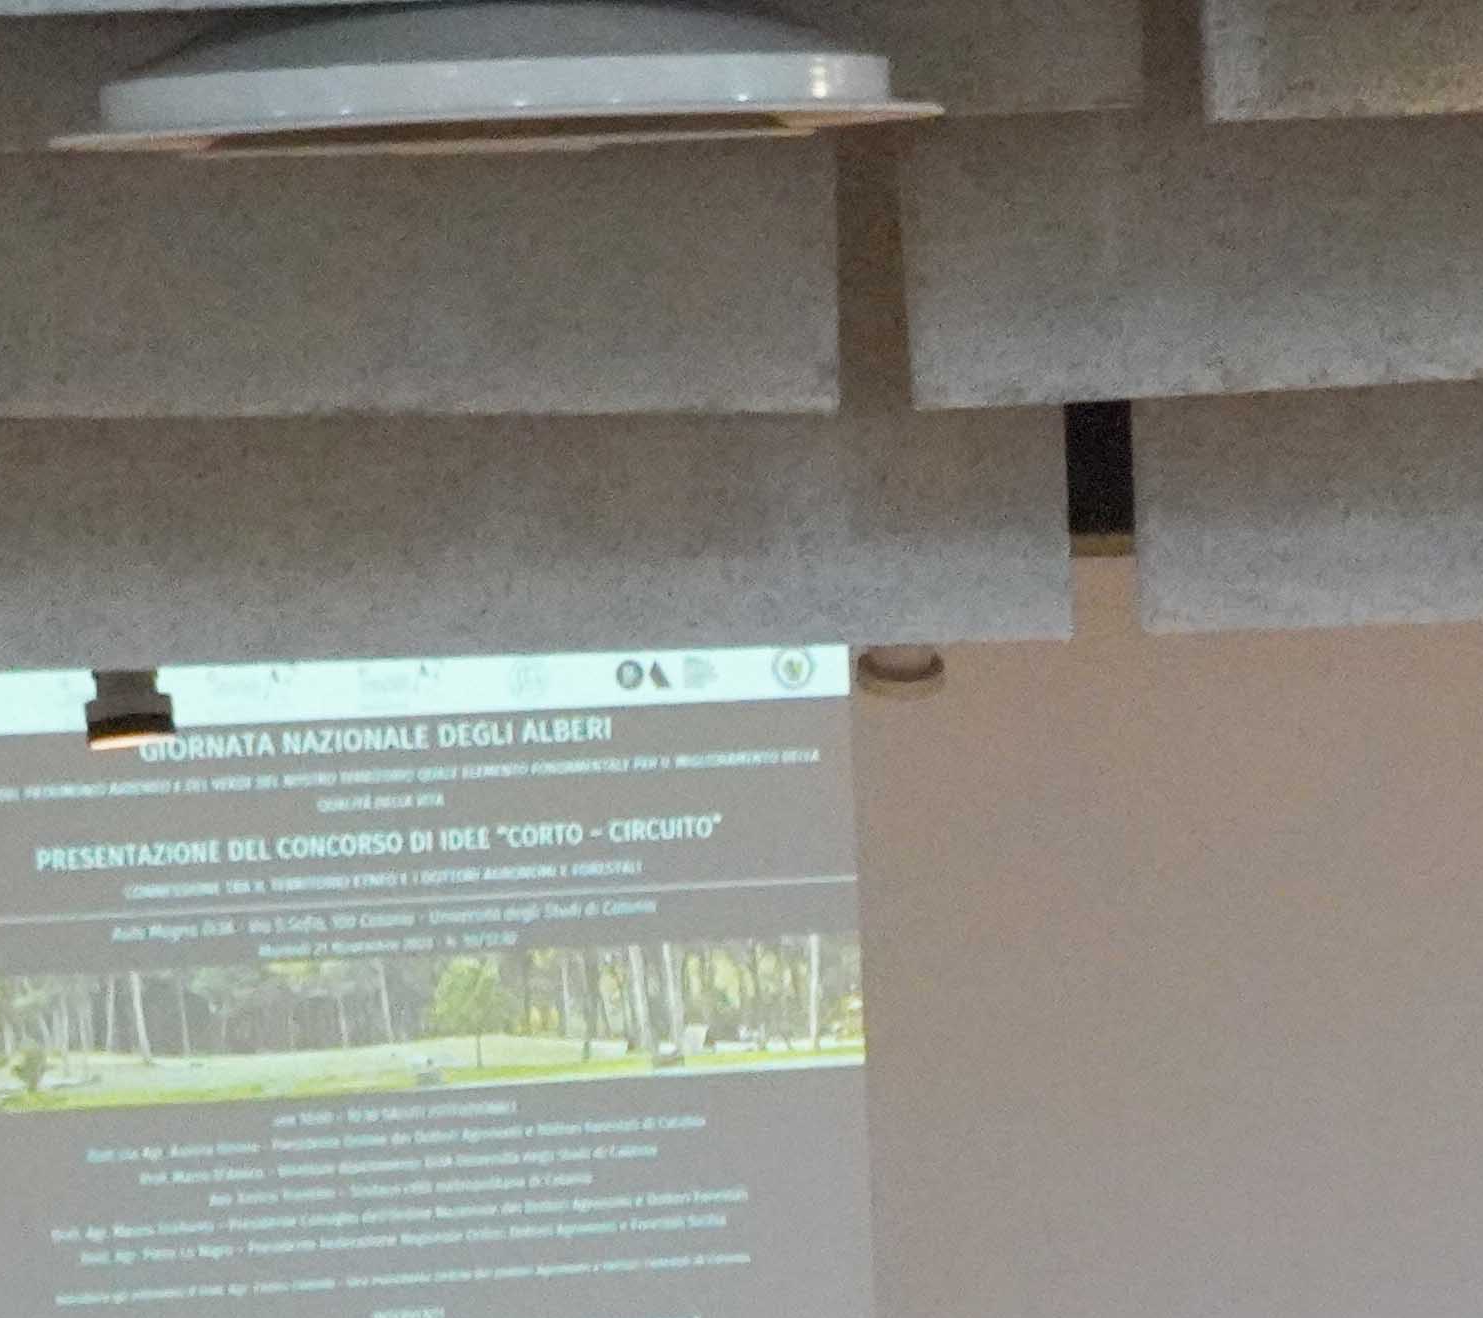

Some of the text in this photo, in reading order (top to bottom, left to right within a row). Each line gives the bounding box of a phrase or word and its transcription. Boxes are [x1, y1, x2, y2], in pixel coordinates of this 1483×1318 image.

[139, 716, 613, 763] GIORNATA NAZIONALE DEGLI ALBERI
[36, 839, 220, 871] PRESENTAZIONE
[228, 838, 270, 863] DEL
[276, 832, 403, 861] CONCORSO
[410, 829, 434, 853] DI
[440, 825, 491, 851] IDEE
